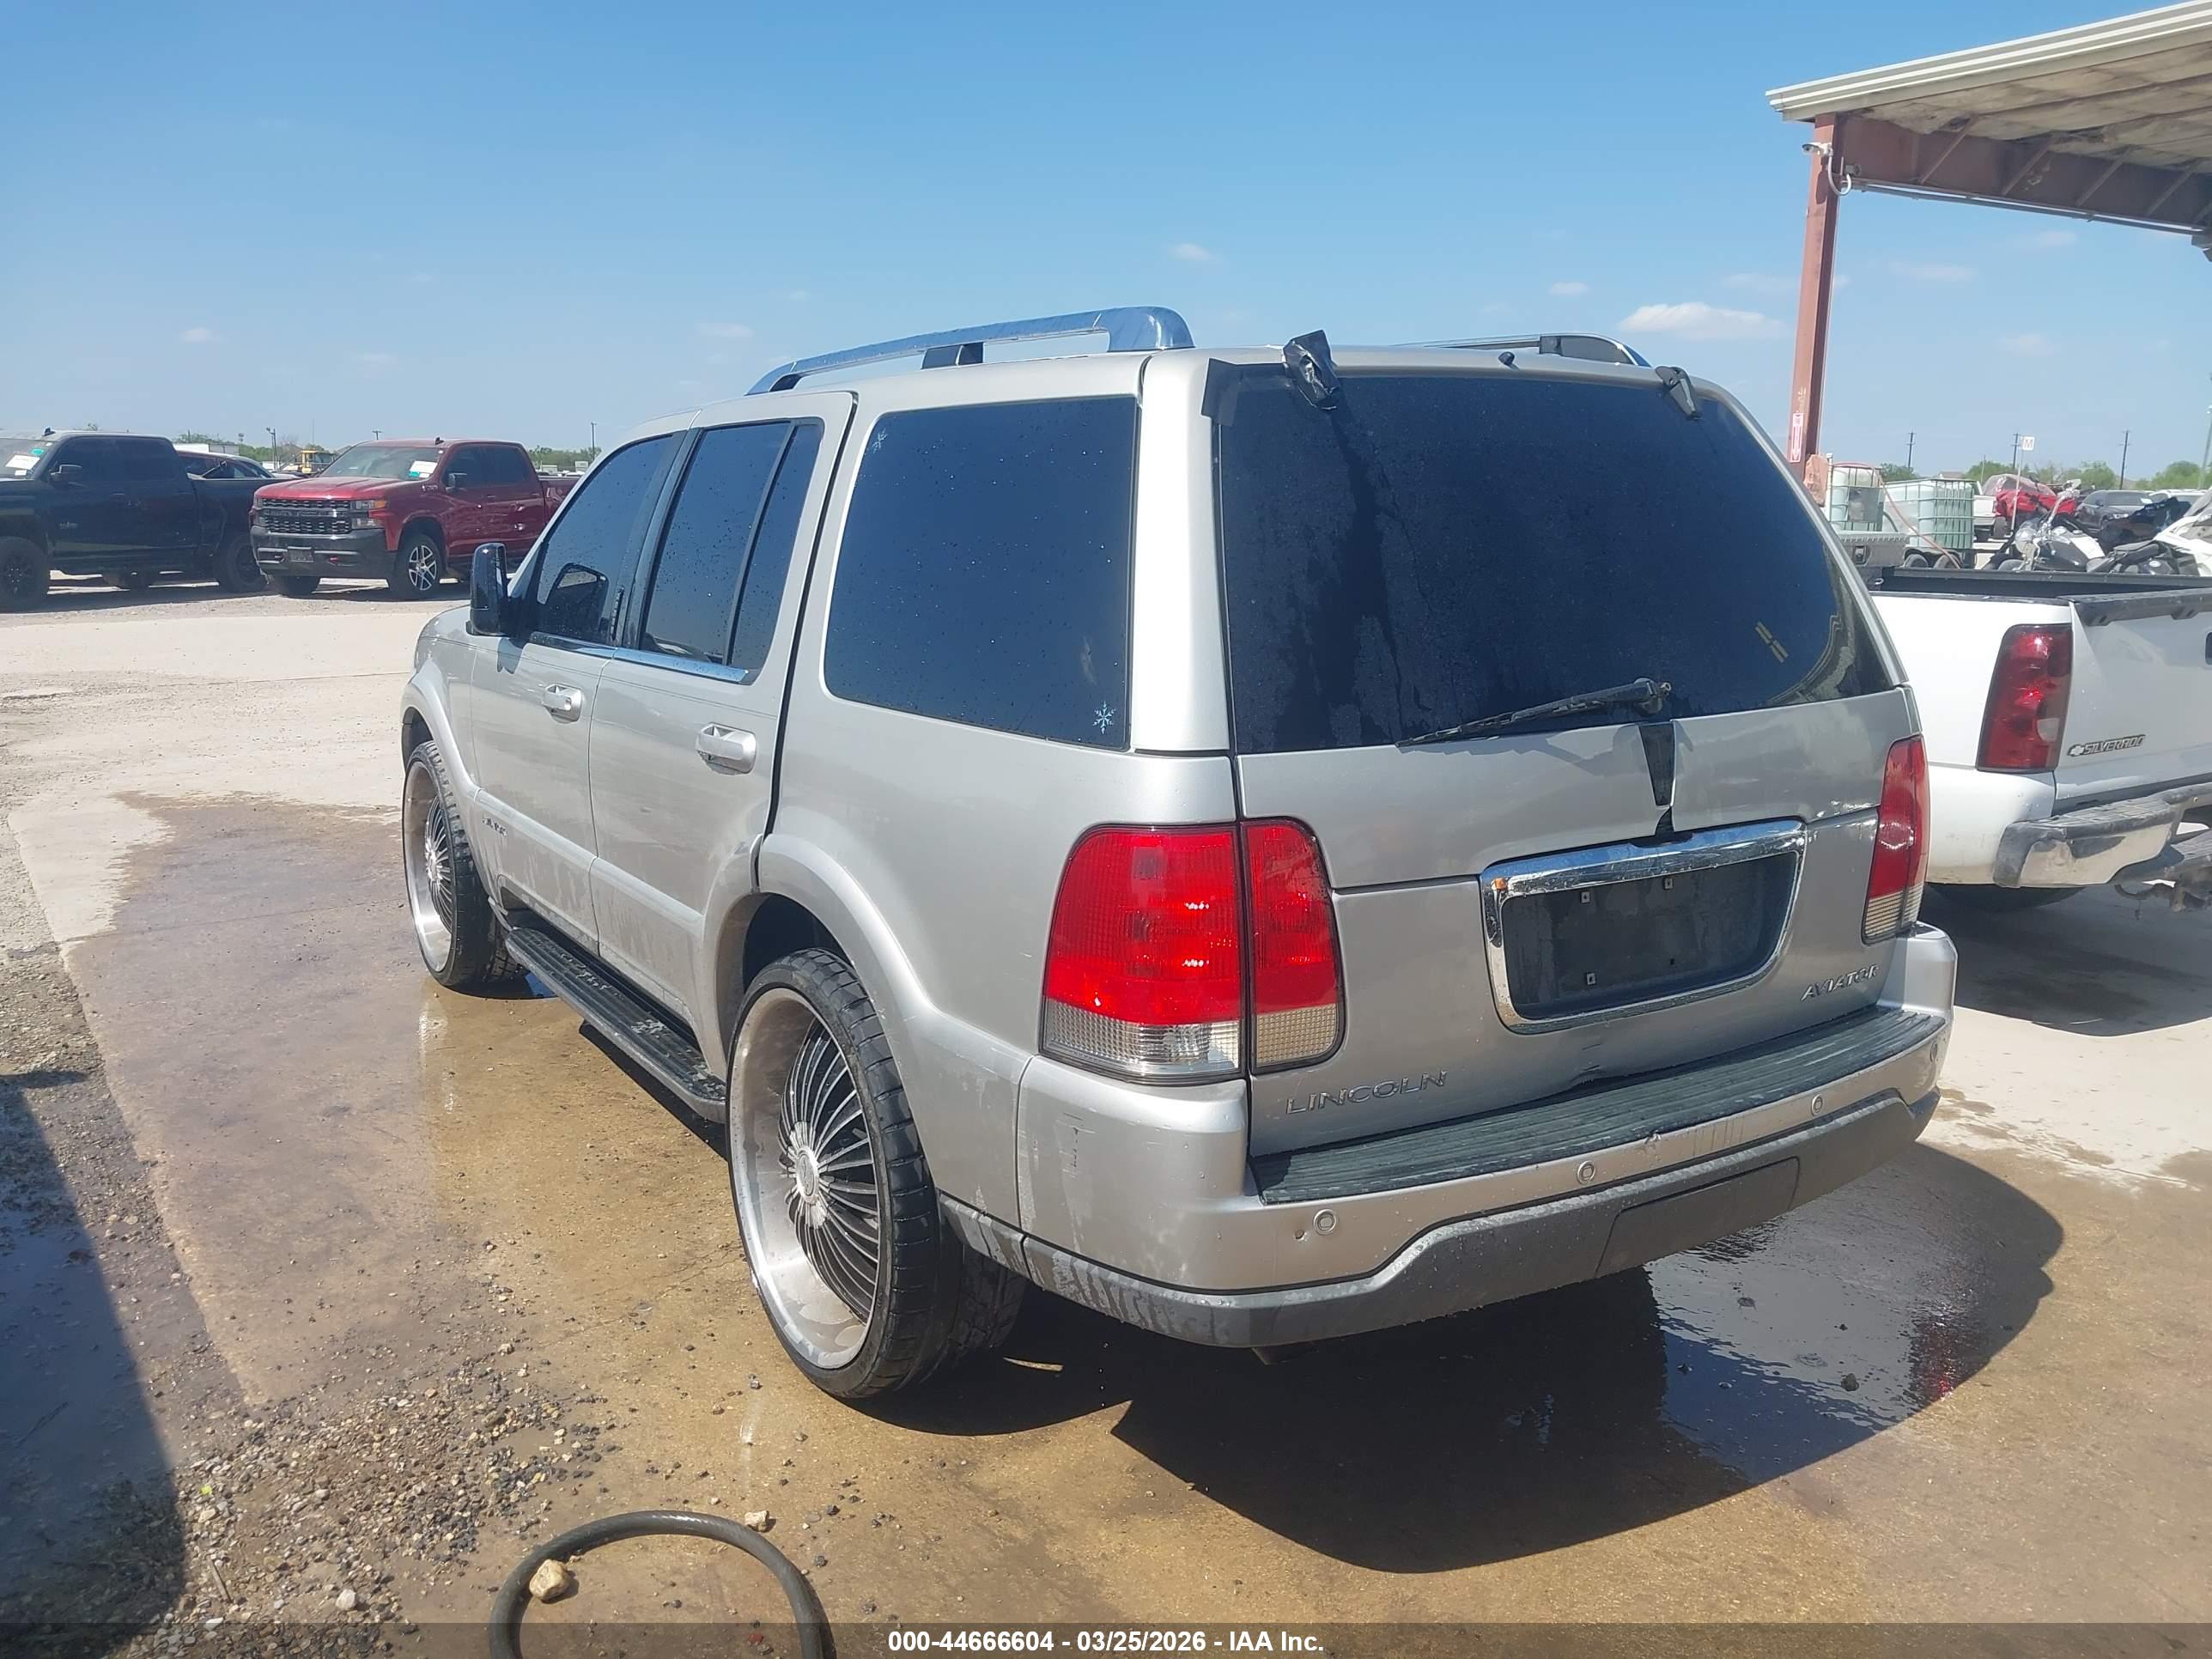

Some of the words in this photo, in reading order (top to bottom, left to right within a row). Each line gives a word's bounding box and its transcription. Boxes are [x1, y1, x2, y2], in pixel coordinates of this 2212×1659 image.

[2084, 736, 2145, 755] SILVERADO
[1800, 963, 1880, 1002] AVIATOR
[1286, 1070, 1448, 1114] LINCOLN
